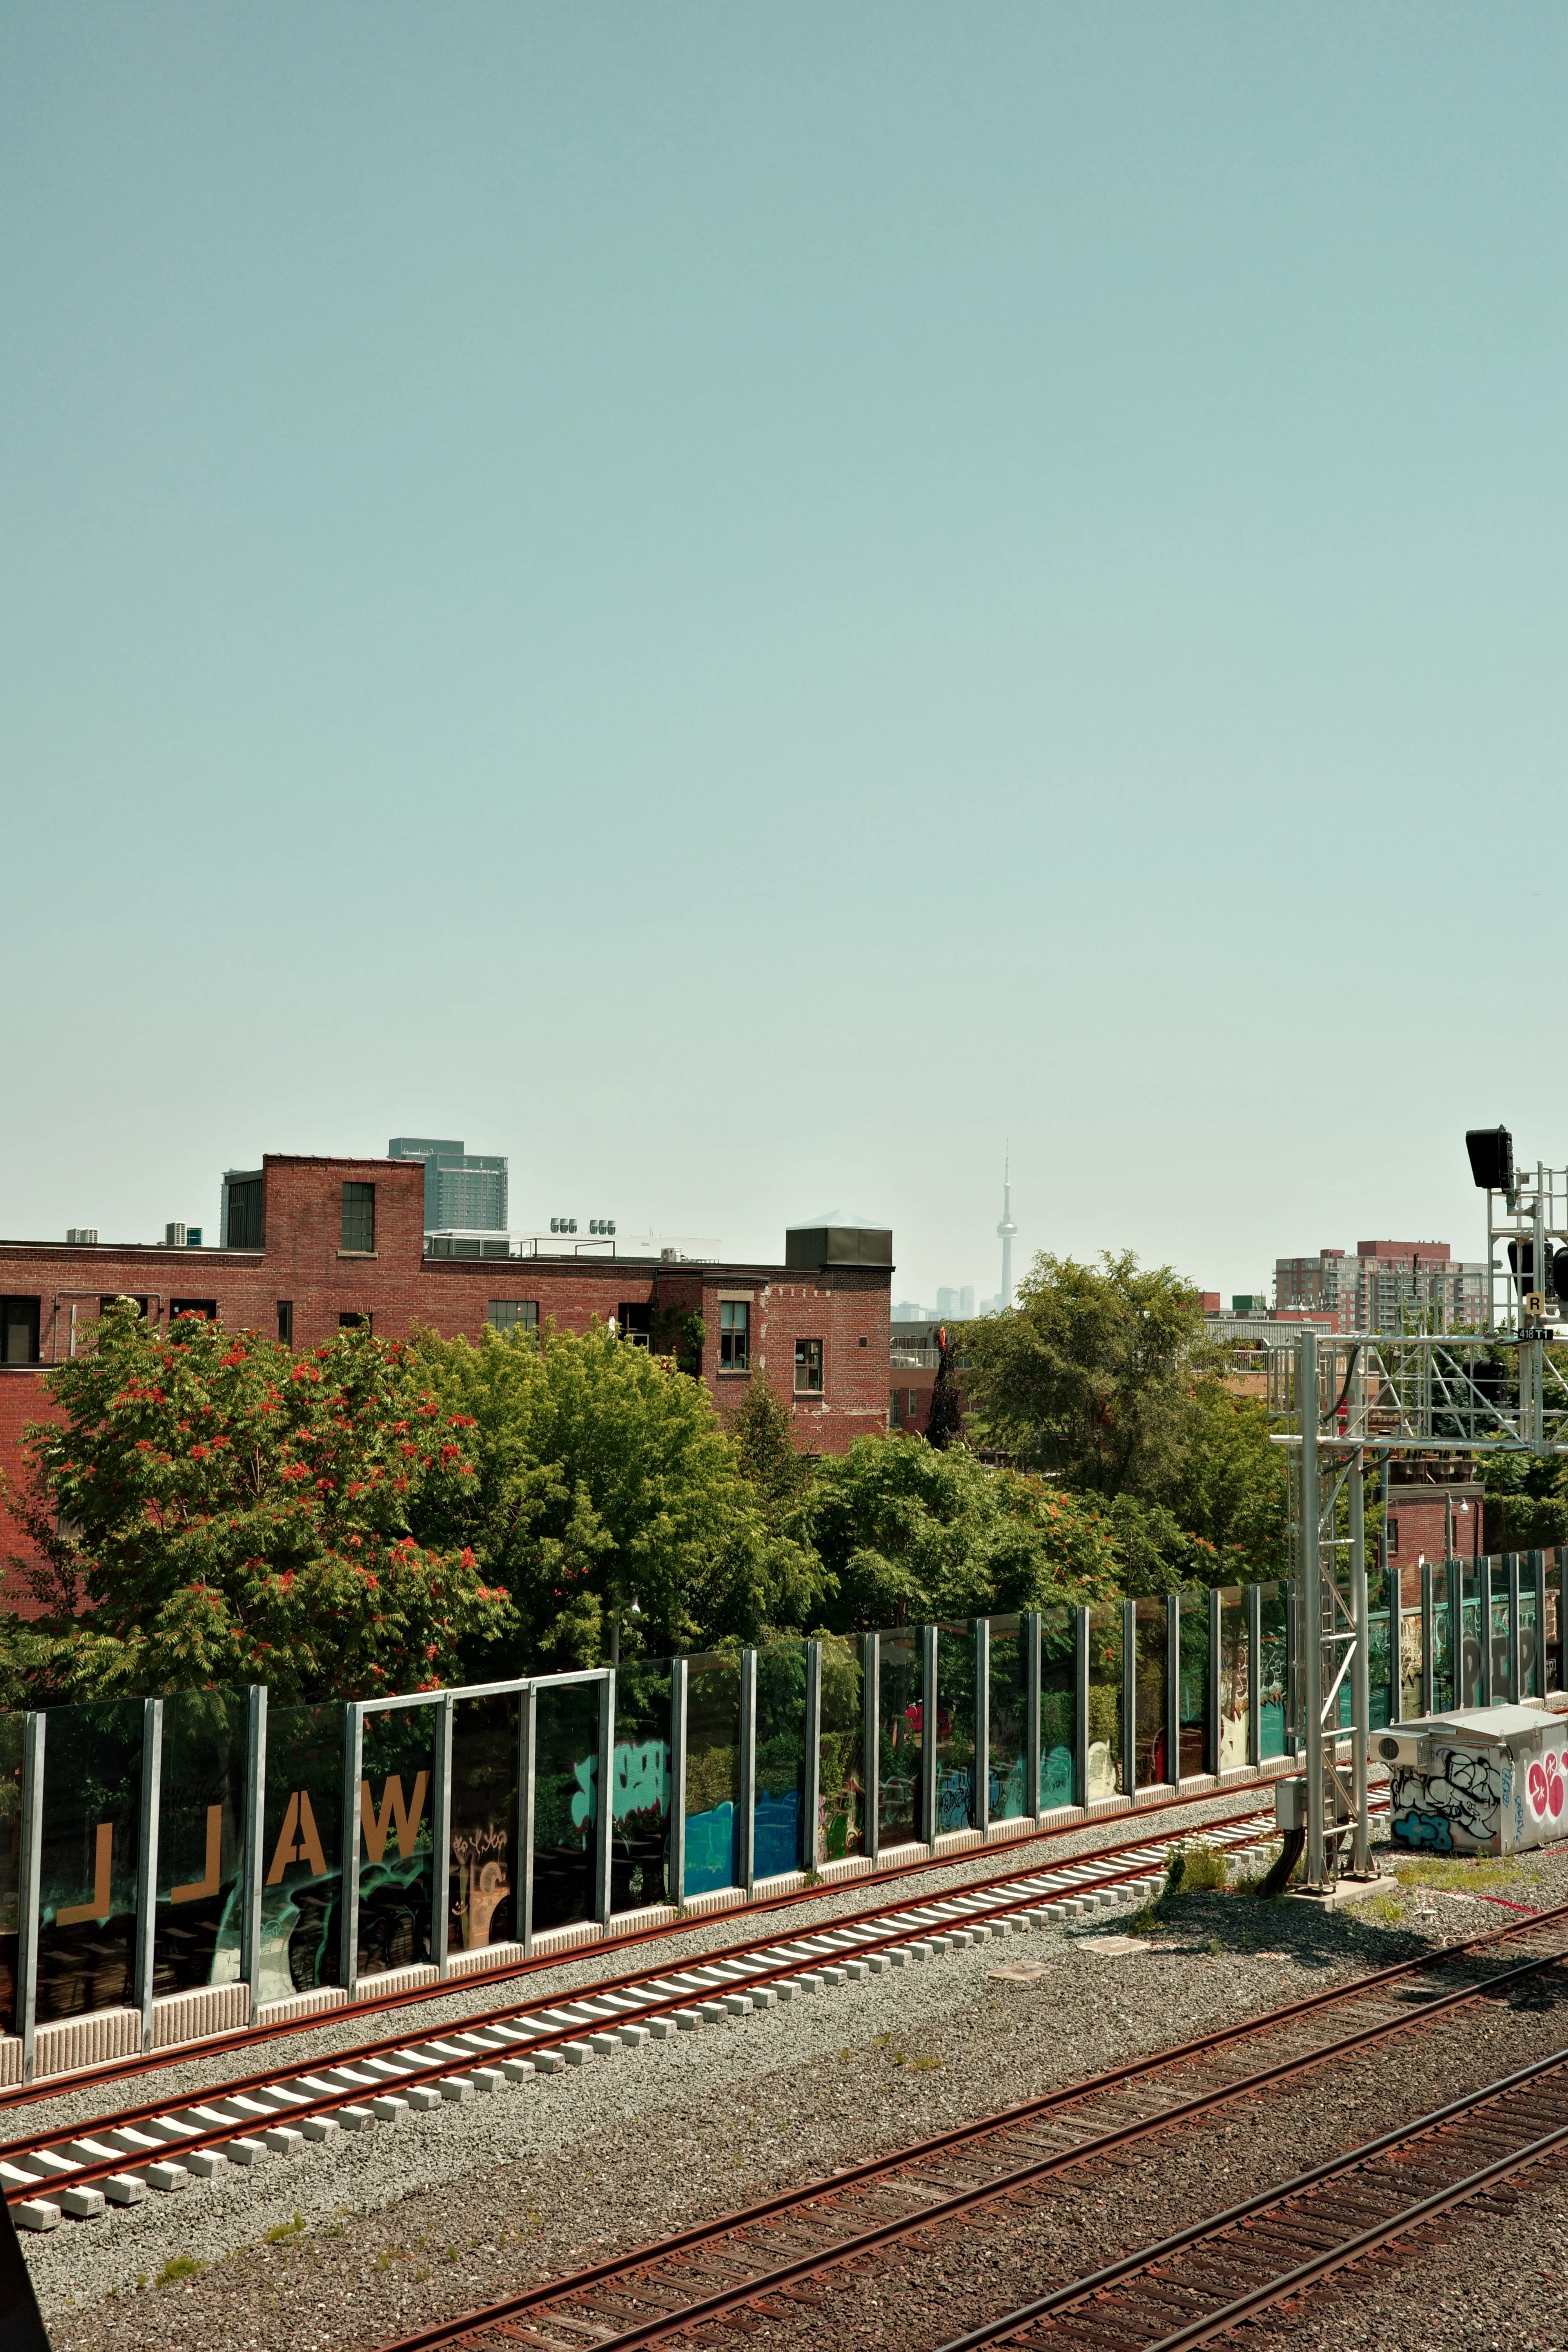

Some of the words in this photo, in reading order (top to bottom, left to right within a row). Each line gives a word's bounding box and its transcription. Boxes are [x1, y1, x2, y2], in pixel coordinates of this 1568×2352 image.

[1530, 1298, 1540, 1310] R
[1520, 1329, 1534, 1338] 418
[1535, 1330, 1548, 1339] T1
[218, 2161, 222, 2170] 5
[176, 2174, 181, 2183] 5
[136, 2186, 140, 2195] 5
[95, 2198, 100, 2207] 5
[52, 2212, 56, 2221] 5
